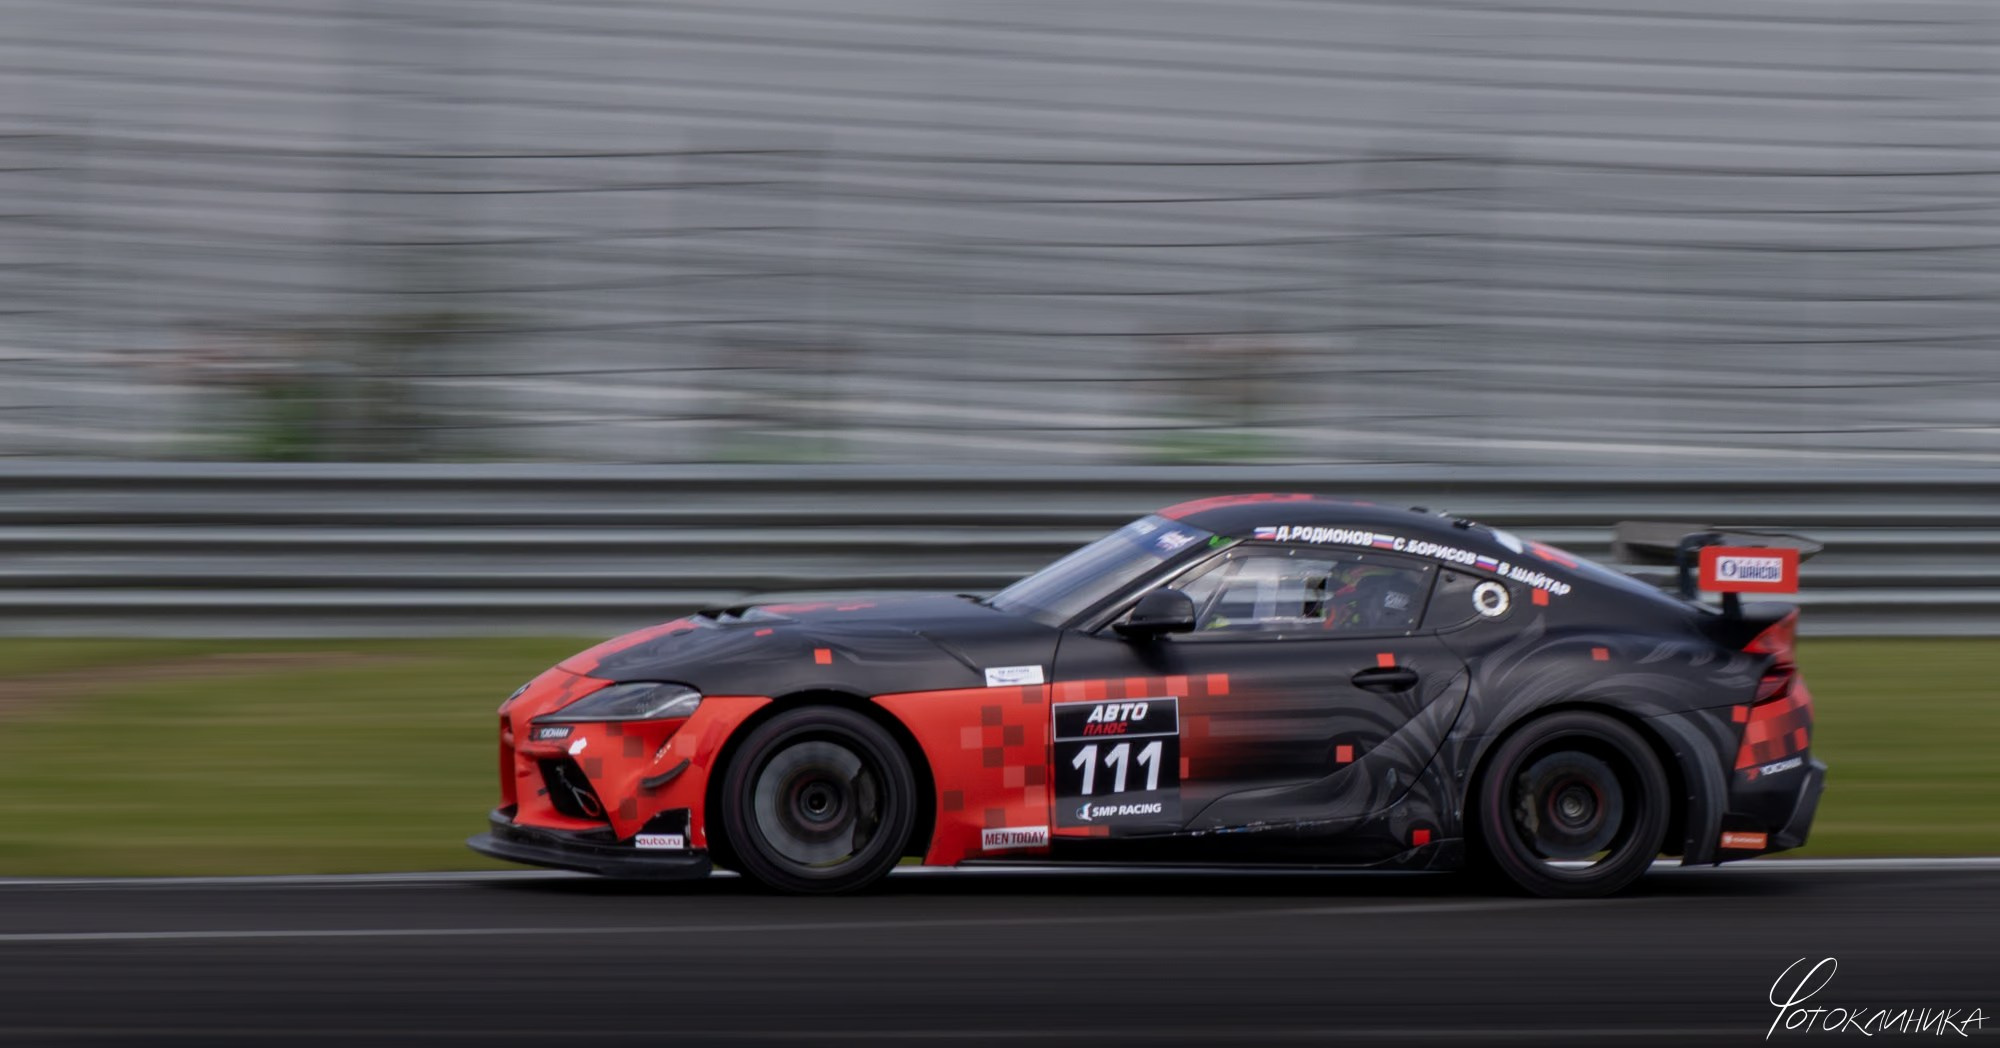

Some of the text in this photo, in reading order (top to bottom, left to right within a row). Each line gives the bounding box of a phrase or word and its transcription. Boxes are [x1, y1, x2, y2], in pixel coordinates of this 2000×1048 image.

[1275, 525, 1373, 546] Д.РОДИОНОВ
[1393, 537, 1476, 566] С.БОРИСОВ
[1497, 562, 1571, 596] В.ШАЙТАР
[1087, 702, 1149, 724] АВТО
[1083, 722, 1127, 736] ПЛЮС
[1072, 741, 1163, 796] 111
[1091, 803, 1162, 818] SMP RACING
[638, 836, 682, 848] auto.ru
[984, 831, 1045, 847] MEN TODAY
